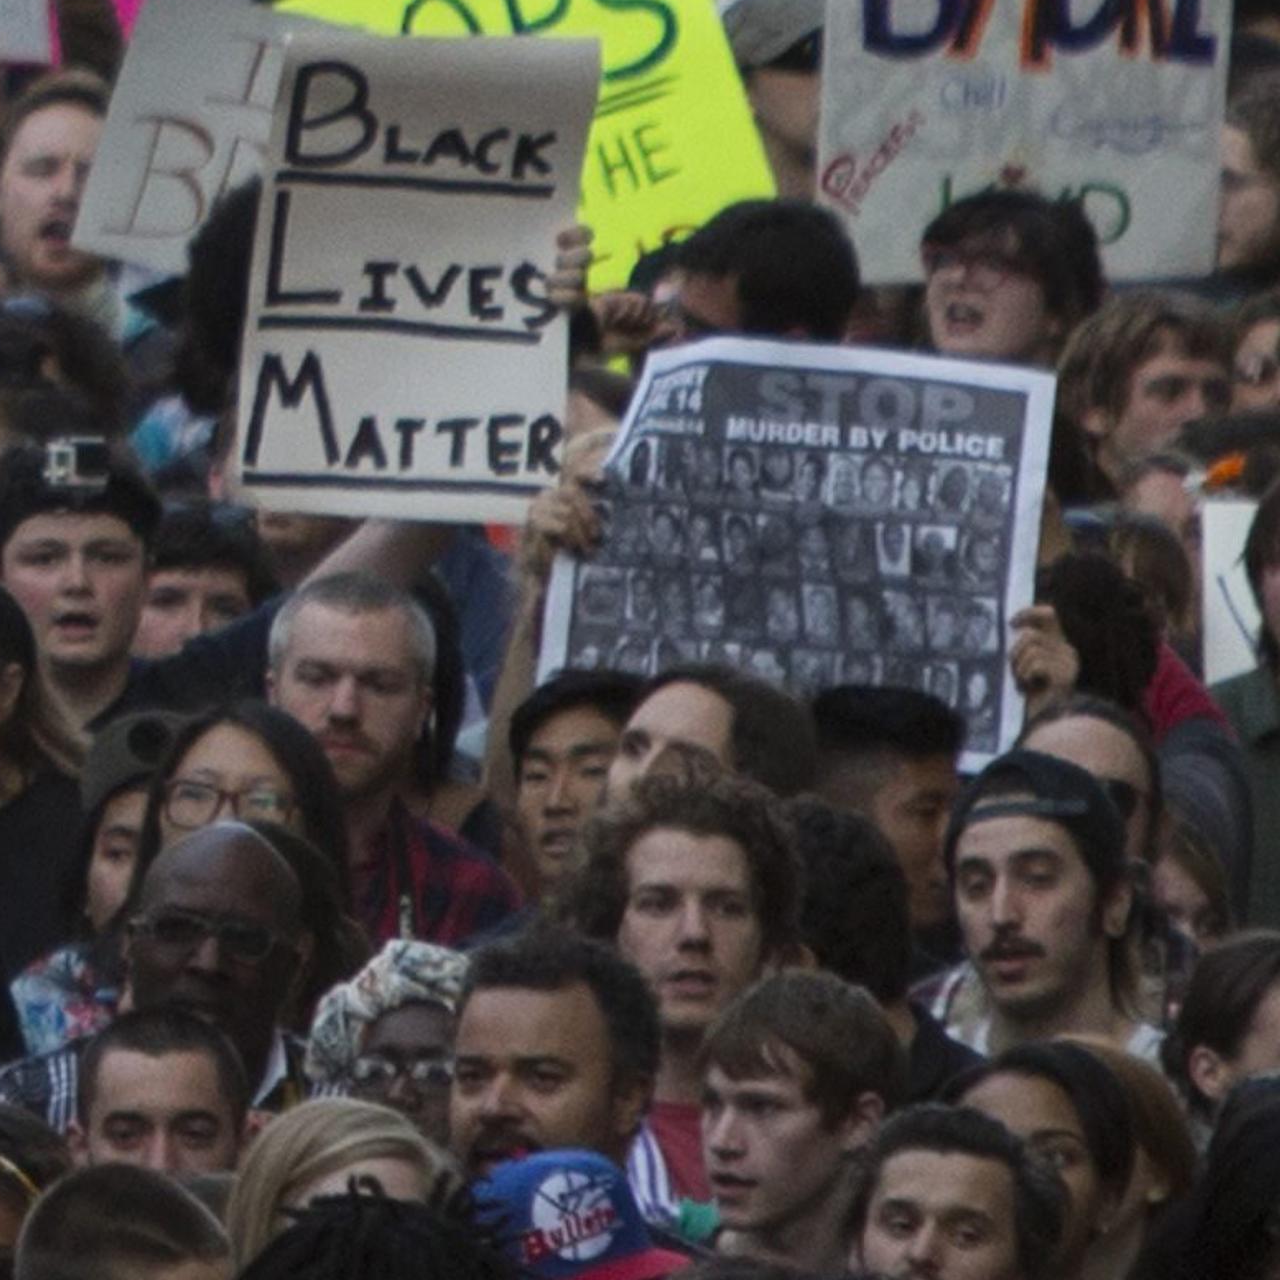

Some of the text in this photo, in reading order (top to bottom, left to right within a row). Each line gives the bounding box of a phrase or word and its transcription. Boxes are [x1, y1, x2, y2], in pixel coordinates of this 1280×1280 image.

[284, 59, 559, 180] BLACK
[264, 186, 564, 329] LIVES
[242, 348, 562, 478] MATTER
[725, 416, 1006, 459] MURDER BY POLICE
[756, 371, 977, 426] STOP
